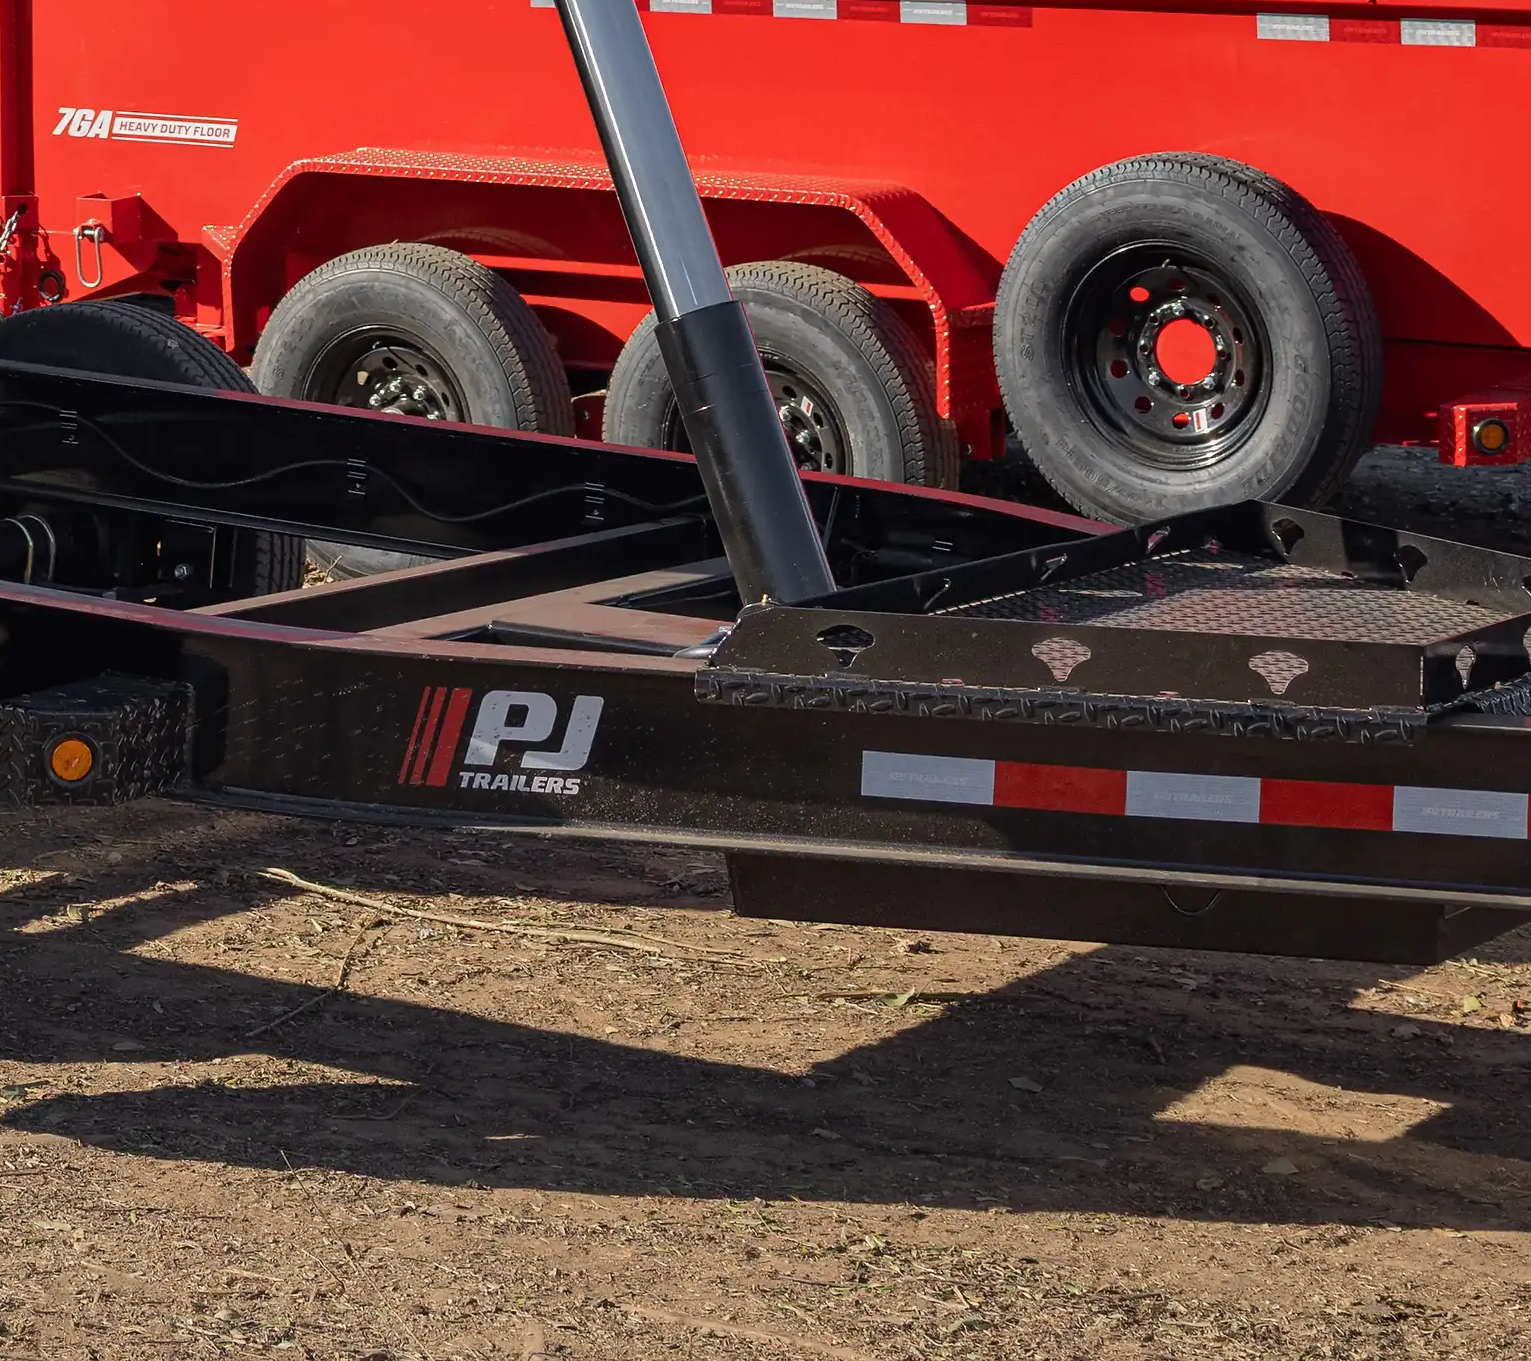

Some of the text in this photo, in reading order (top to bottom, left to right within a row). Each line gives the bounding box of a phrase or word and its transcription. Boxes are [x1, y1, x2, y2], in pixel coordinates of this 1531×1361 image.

[52, 107, 232, 139] 7GA HEAVY DUTY FLOOR
[464, 689, 604, 771] PJ
[459, 771, 581, 795] TRAILERS
